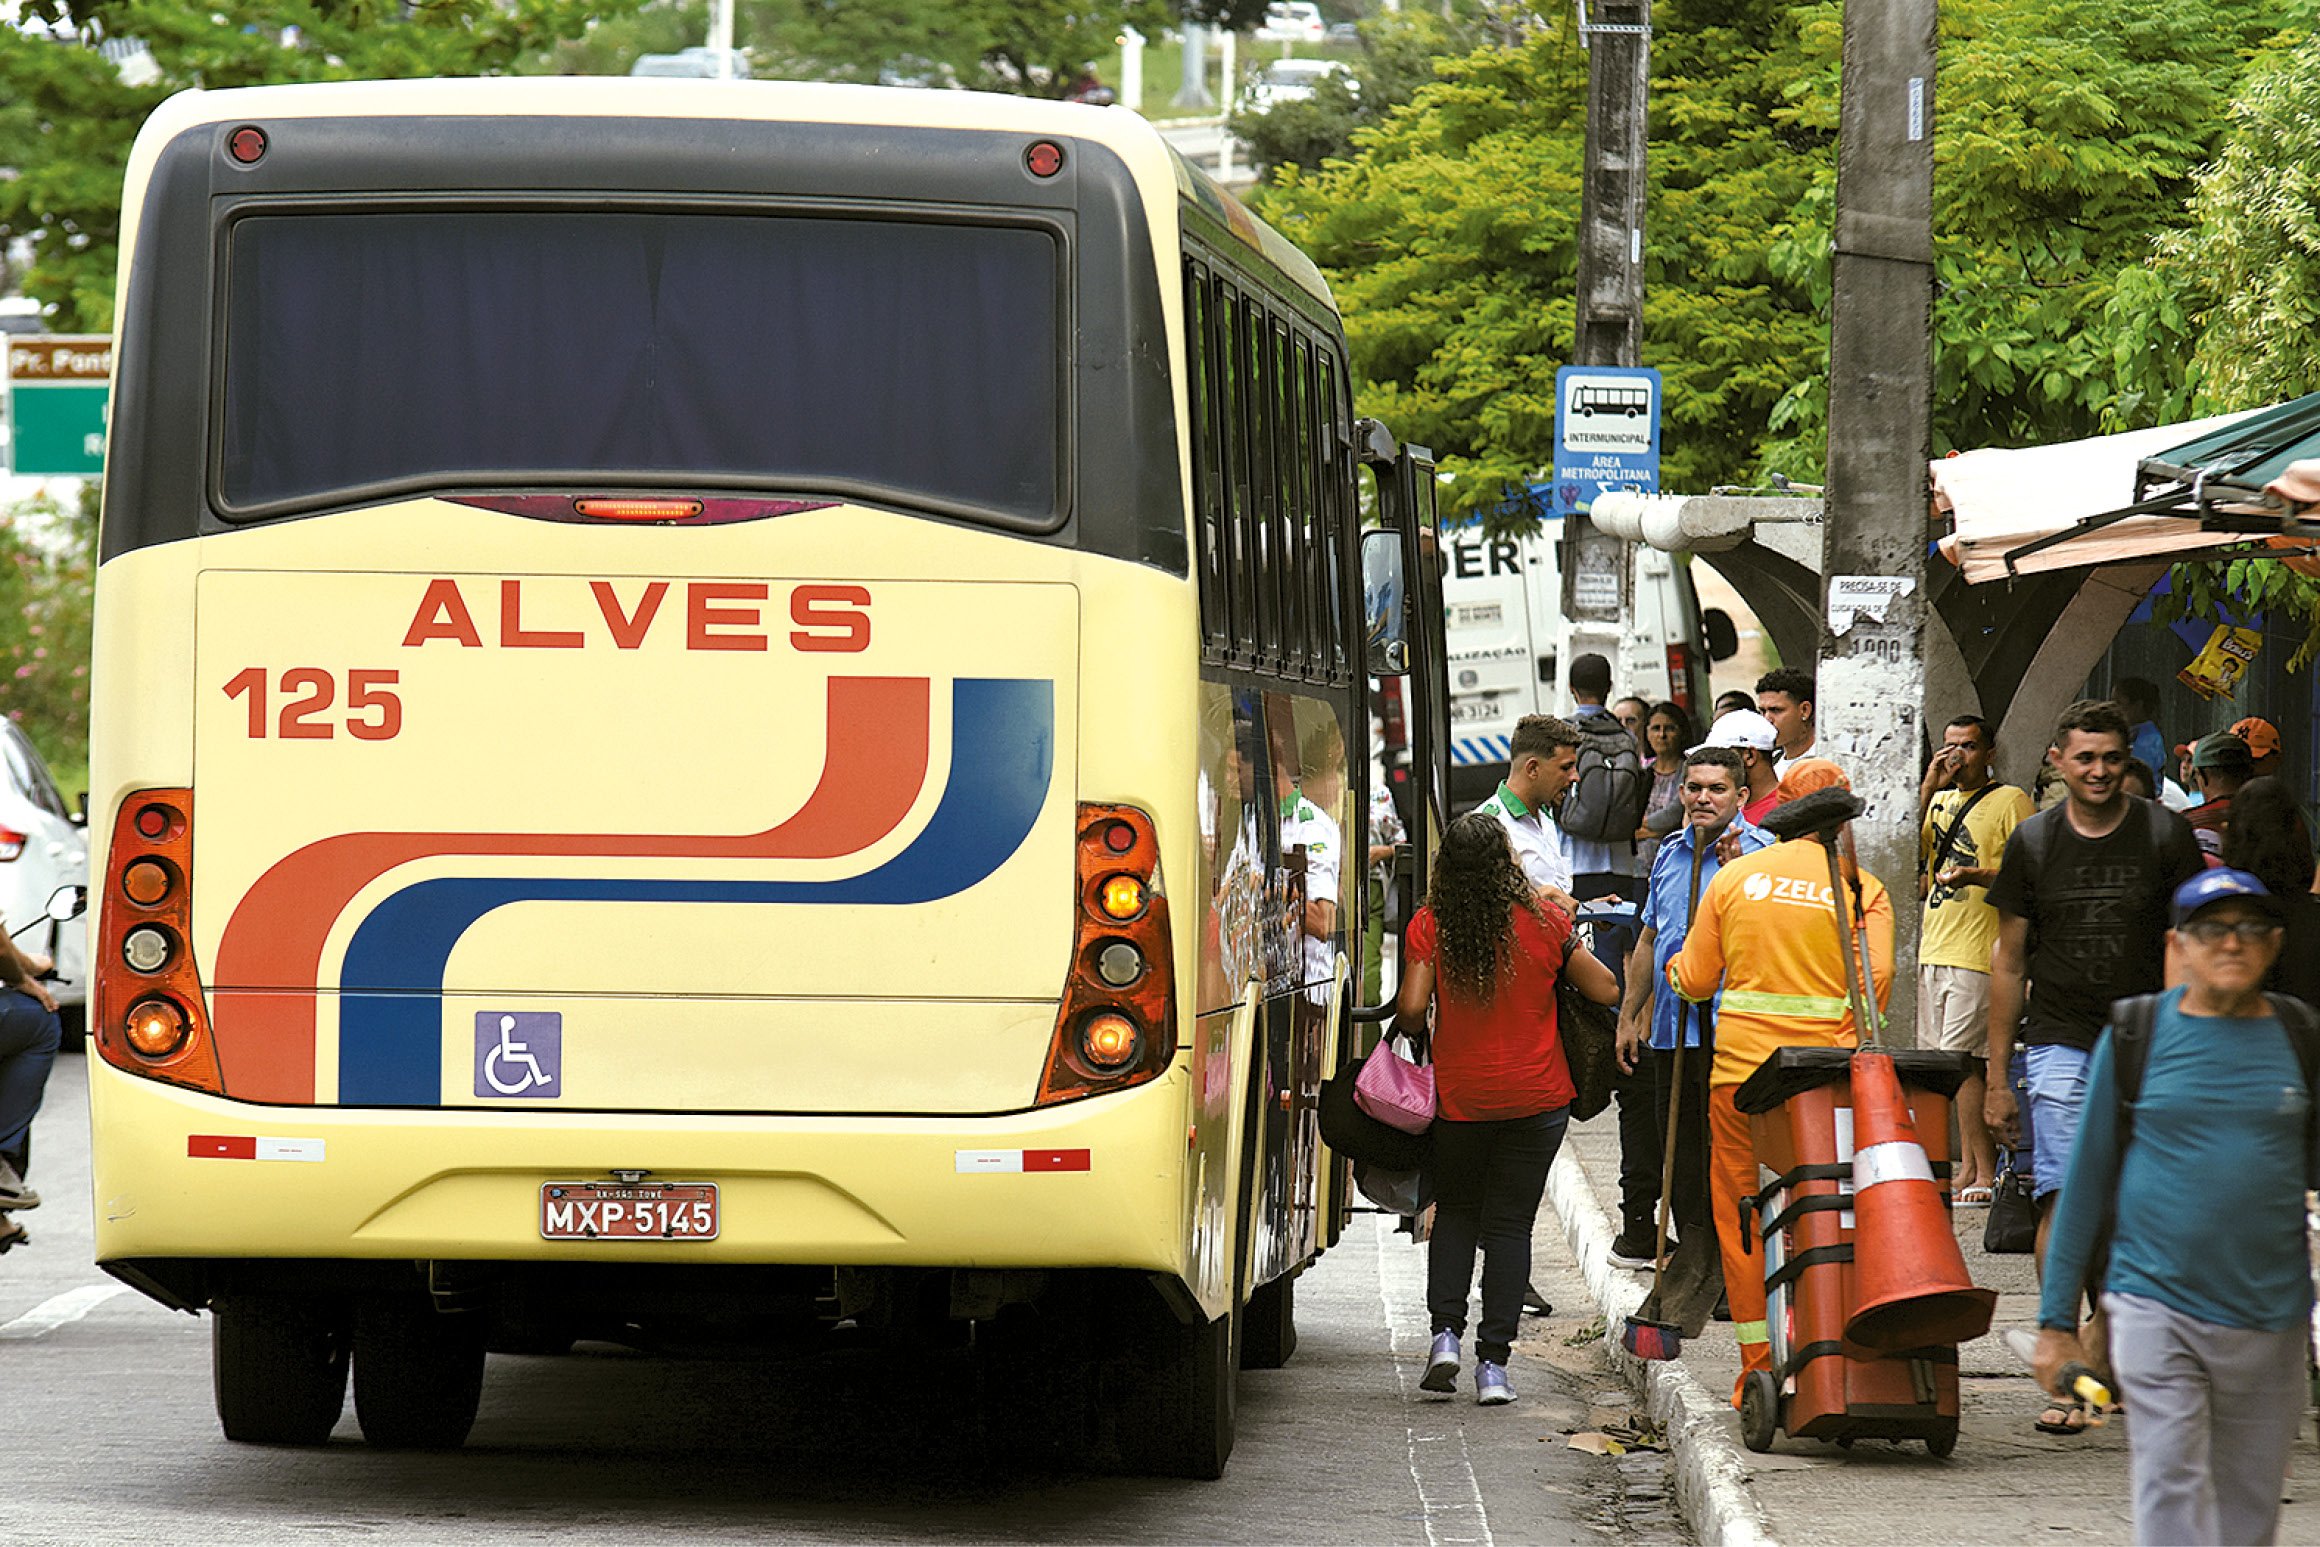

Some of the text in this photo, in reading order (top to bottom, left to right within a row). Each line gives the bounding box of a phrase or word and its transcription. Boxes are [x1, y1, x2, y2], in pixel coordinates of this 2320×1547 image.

[1569, 433, 1645, 444] INTERMUNICIPAL
[1592, 454, 1621, 468] ÁREA
[1561, 467, 1651, 480] METROPOLITANA
[401, 578, 871, 653] ALVES
[222, 667, 402, 741] 125
